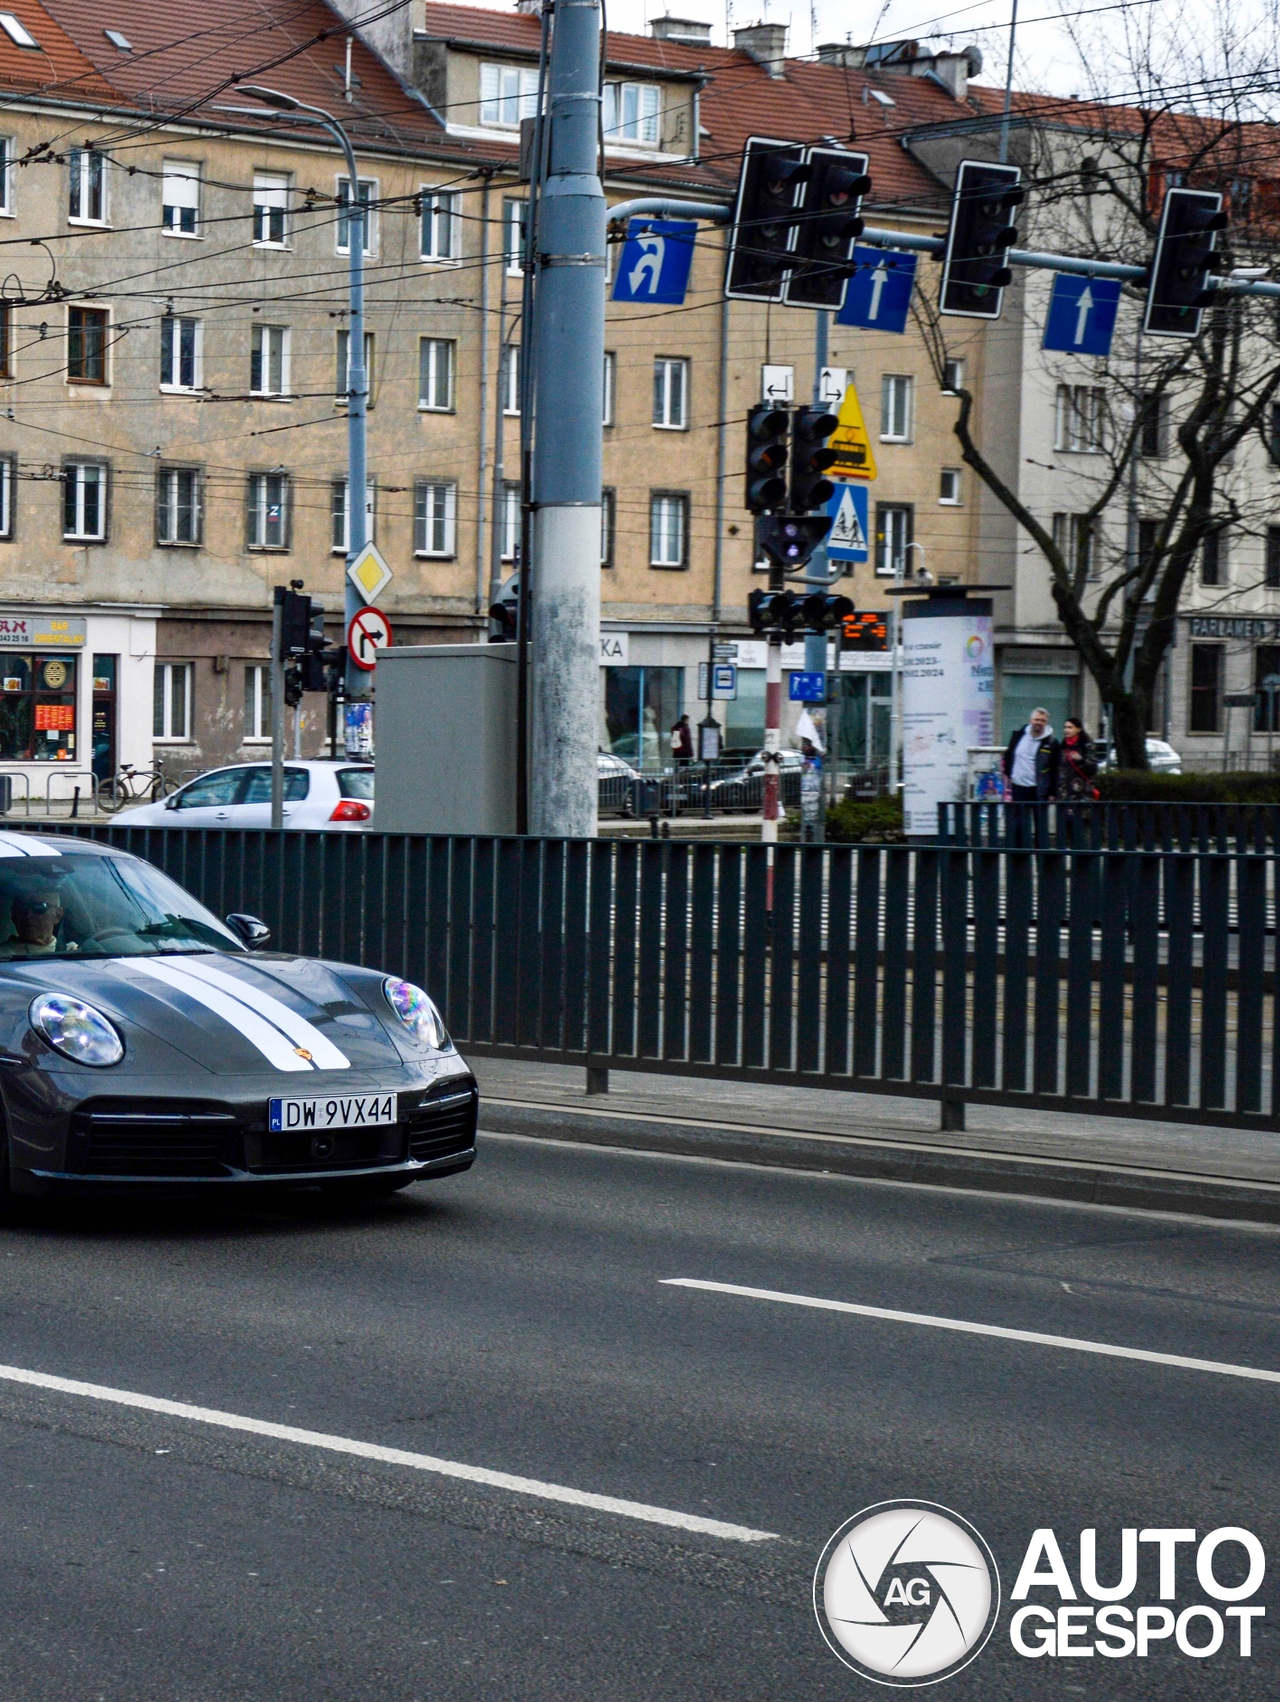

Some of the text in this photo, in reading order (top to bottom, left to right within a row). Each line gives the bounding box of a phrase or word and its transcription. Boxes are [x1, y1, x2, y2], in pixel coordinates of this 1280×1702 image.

[51, 620, 68, 631] BAR
[33, 633, 85, 644] ORIENTALNY
[601, 638, 624, 657] KA
[287, 1096, 392, 1128] DW 9VX44
[272, 1118, 281, 1126] PL
